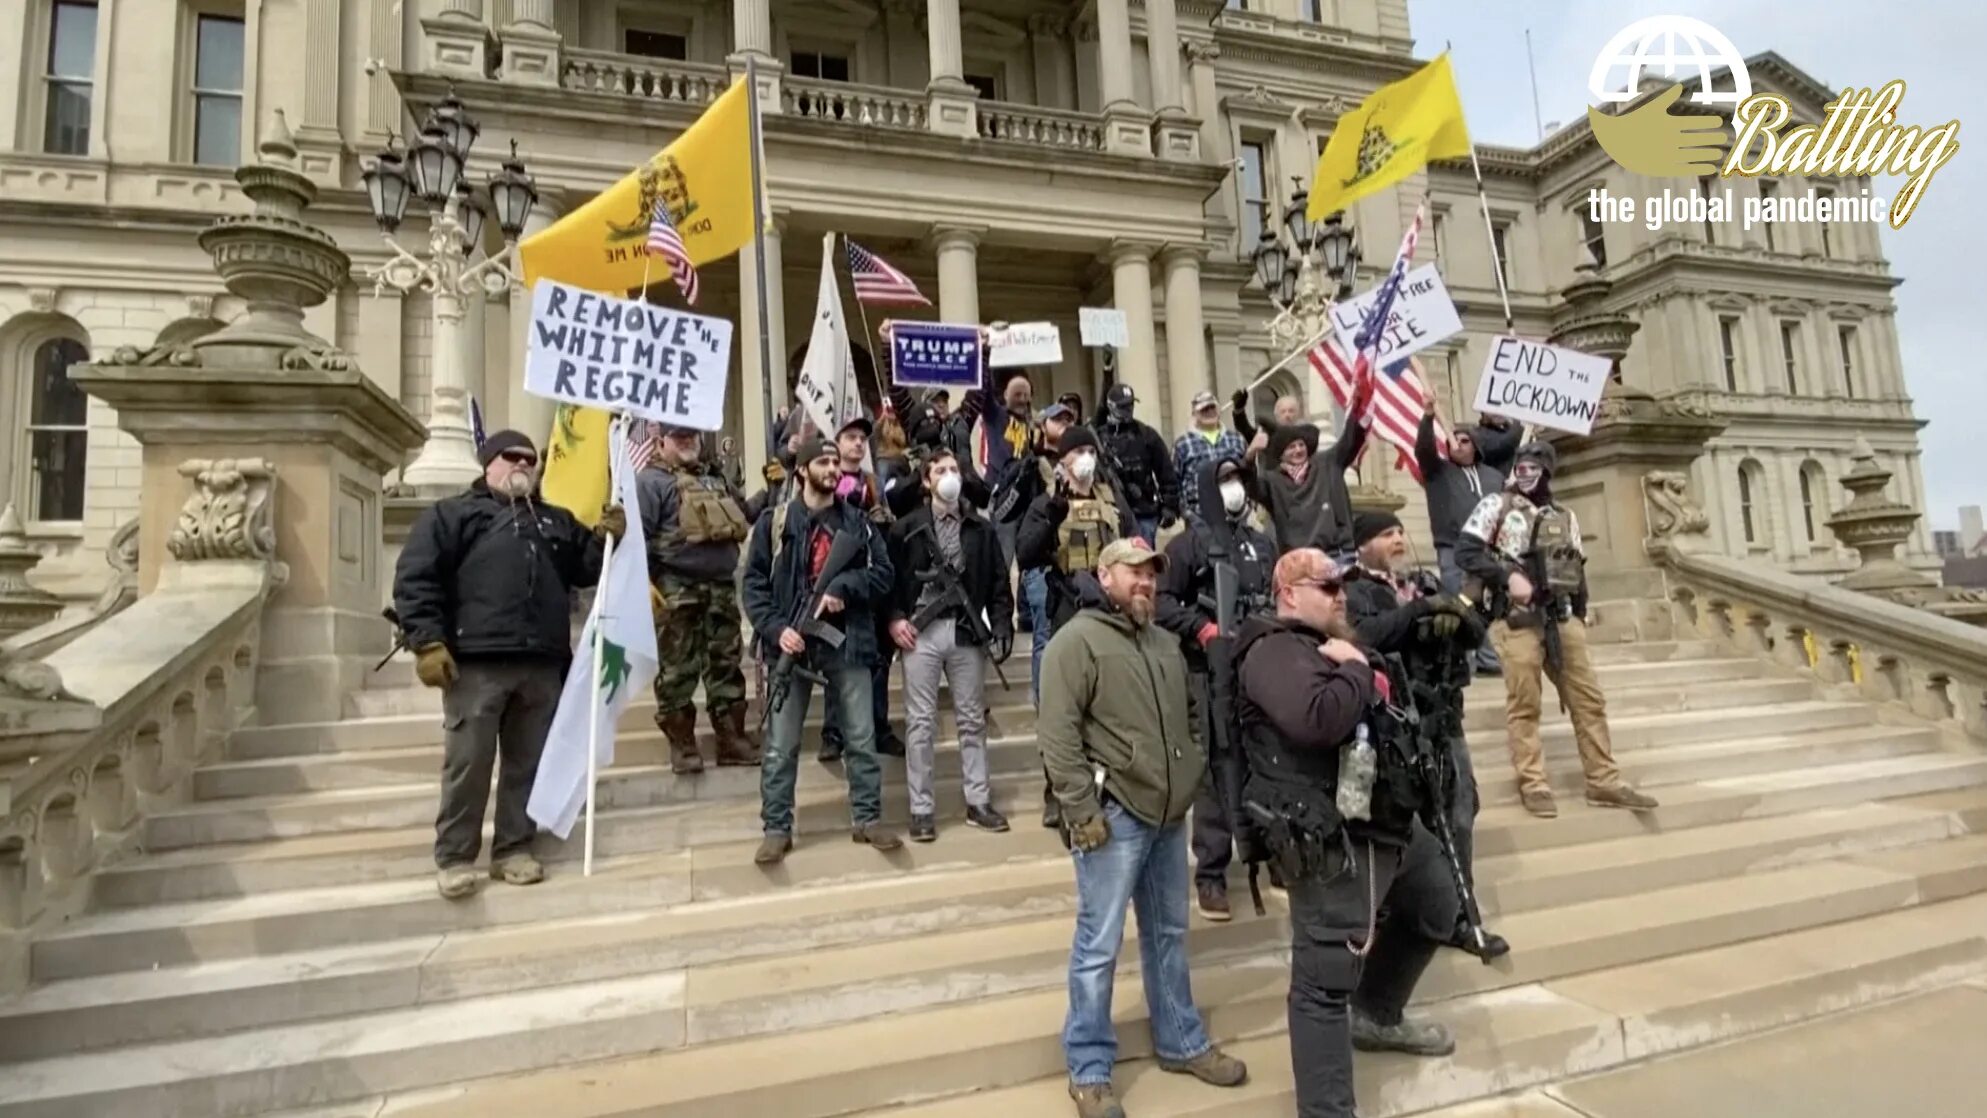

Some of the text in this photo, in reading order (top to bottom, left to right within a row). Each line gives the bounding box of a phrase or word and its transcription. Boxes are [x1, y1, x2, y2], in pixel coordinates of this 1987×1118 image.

[546, 286, 720, 353] REMOVE THE
[535, 320, 698, 381] WHITMER
[898, 337, 974, 354] TRUMP
[905, 352, 967, 364] PENCE
[1493, 338, 1590, 384] END THE
[554, 359, 692, 415] REGIME
[1486, 376, 1597, 423] LOCKDOWN
